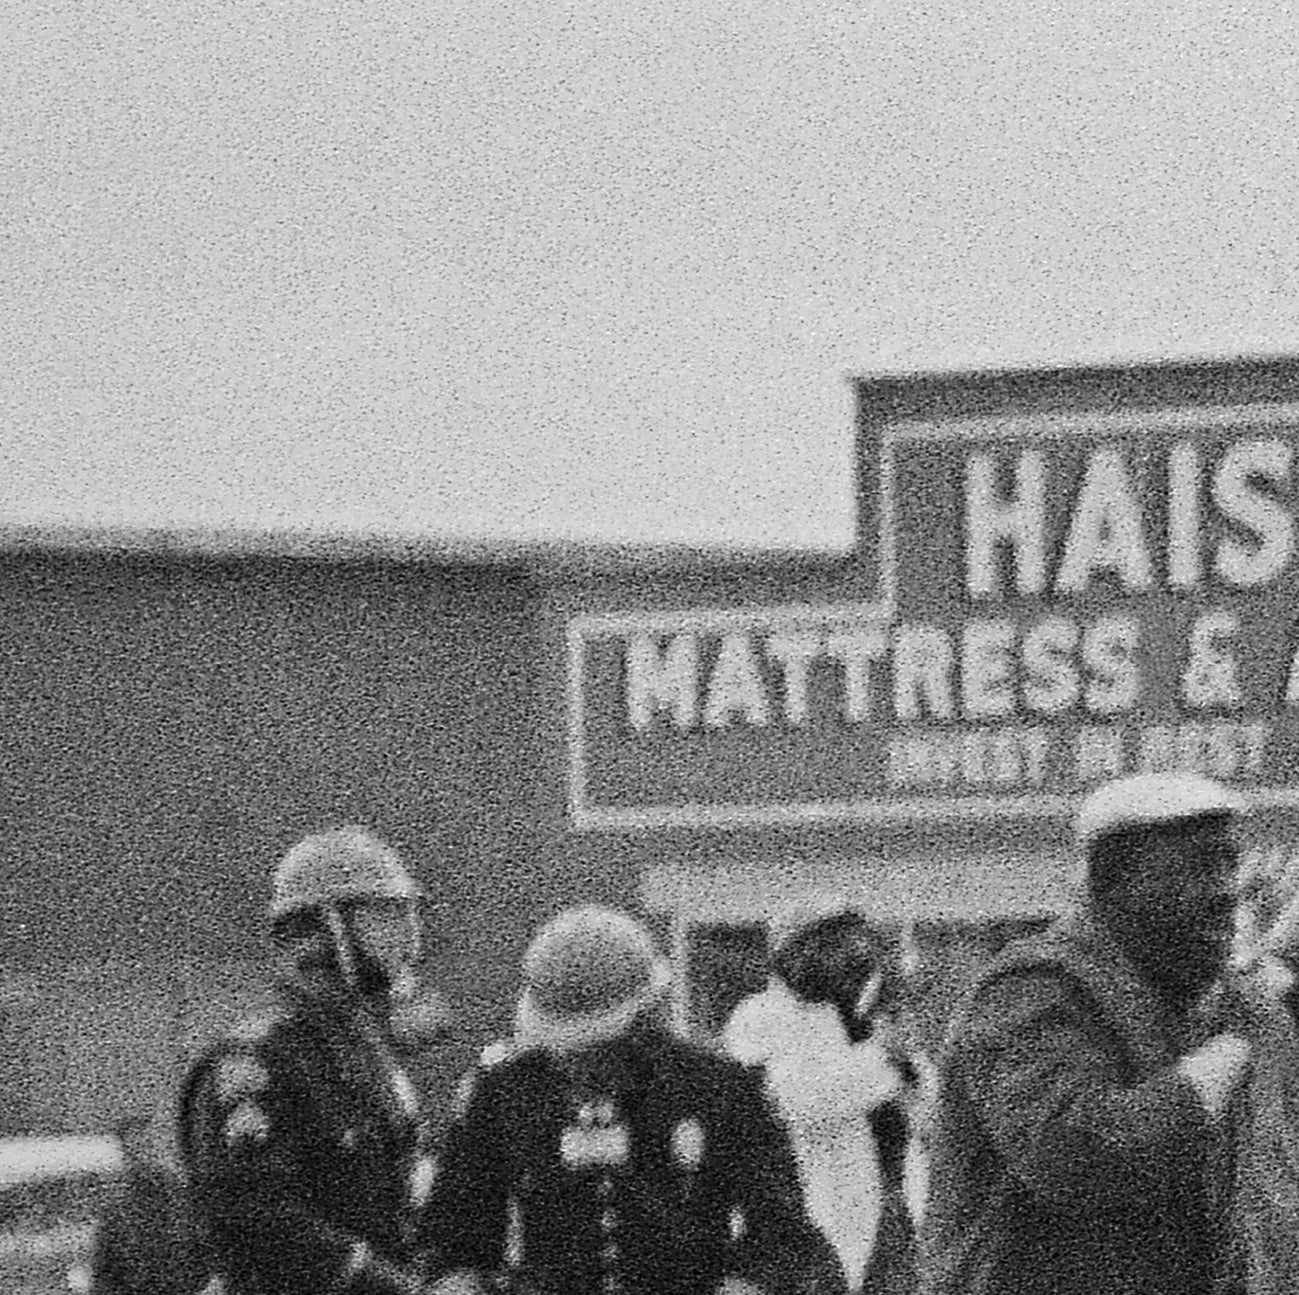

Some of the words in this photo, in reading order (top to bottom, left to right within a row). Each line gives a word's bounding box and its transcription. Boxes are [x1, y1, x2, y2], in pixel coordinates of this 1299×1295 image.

[625, 614, 1140, 729] MATTRESS
[1180, 611, 1241, 708] &
[888, 725, 1049, 785] INVEST
[1075, 724, 1123, 777] IN
